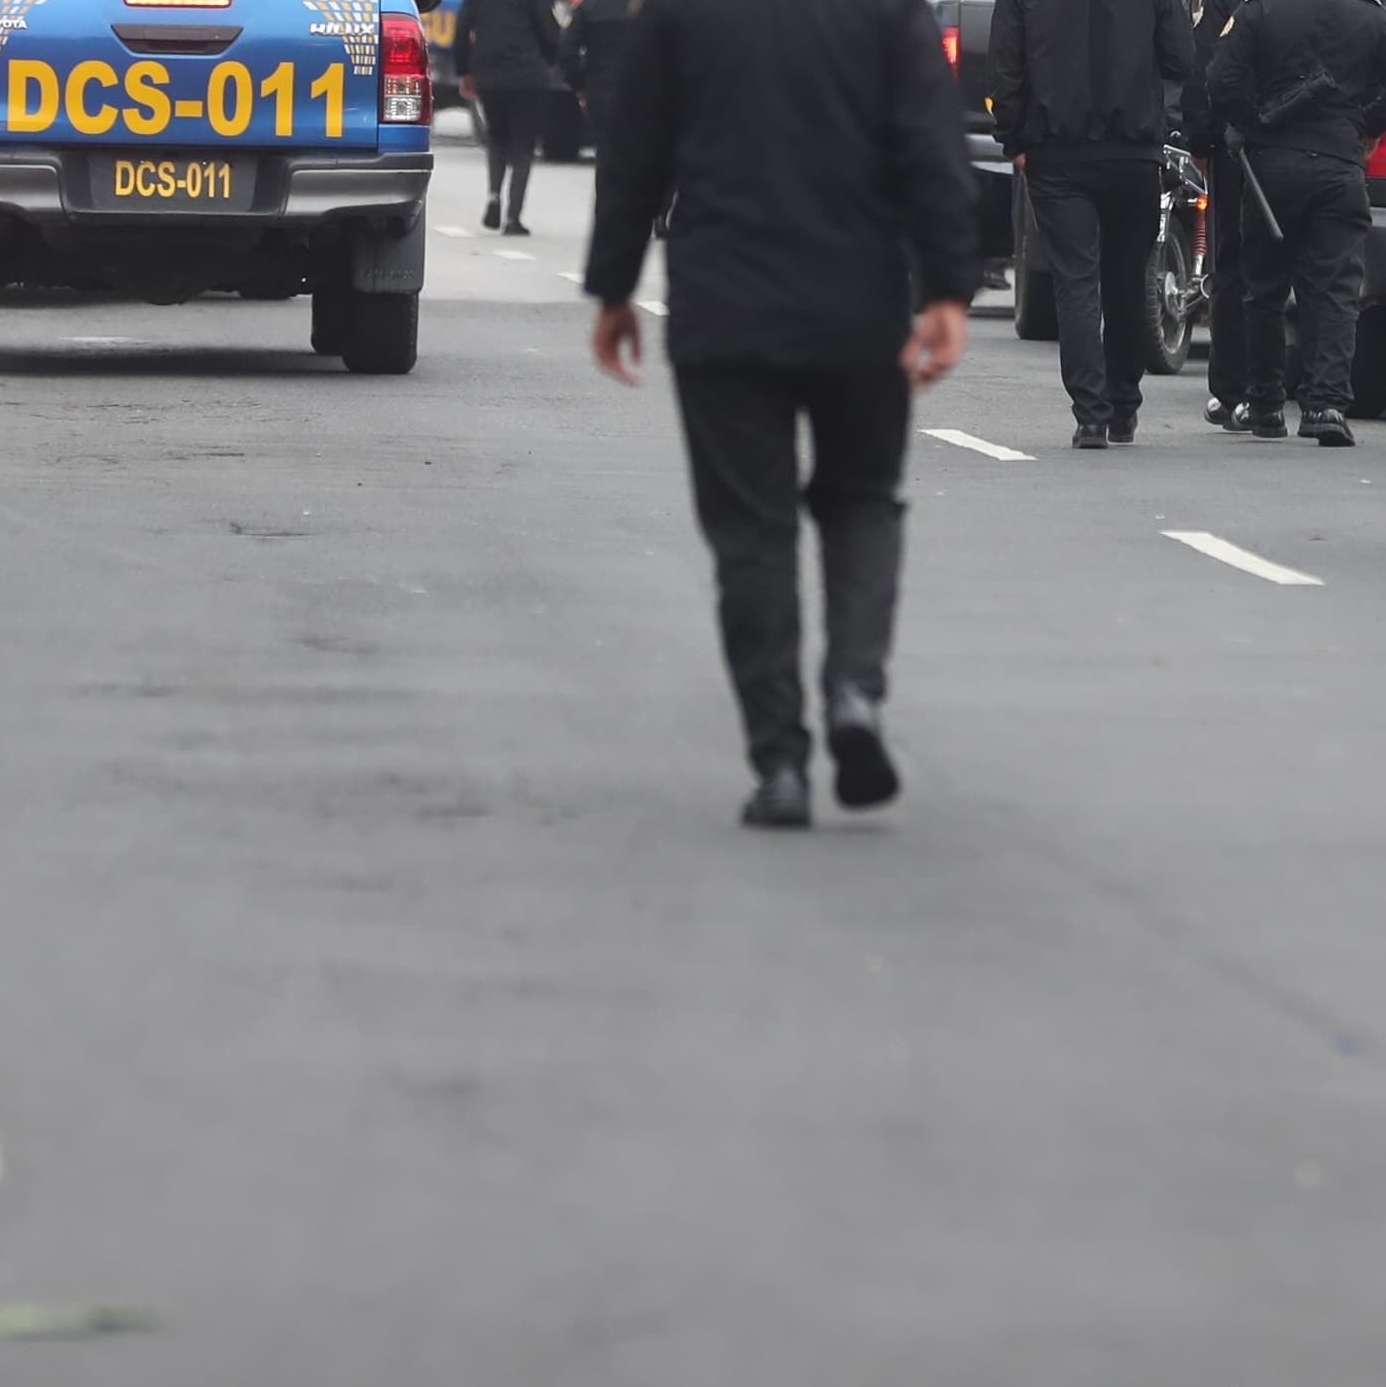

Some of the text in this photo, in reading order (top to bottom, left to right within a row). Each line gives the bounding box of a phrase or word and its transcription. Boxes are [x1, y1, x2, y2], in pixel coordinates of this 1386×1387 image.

[309, 22, 377, 35] HILUX
[6, 59, 345, 137] DCS-011
[115, 160, 232, 198] DCS-011
